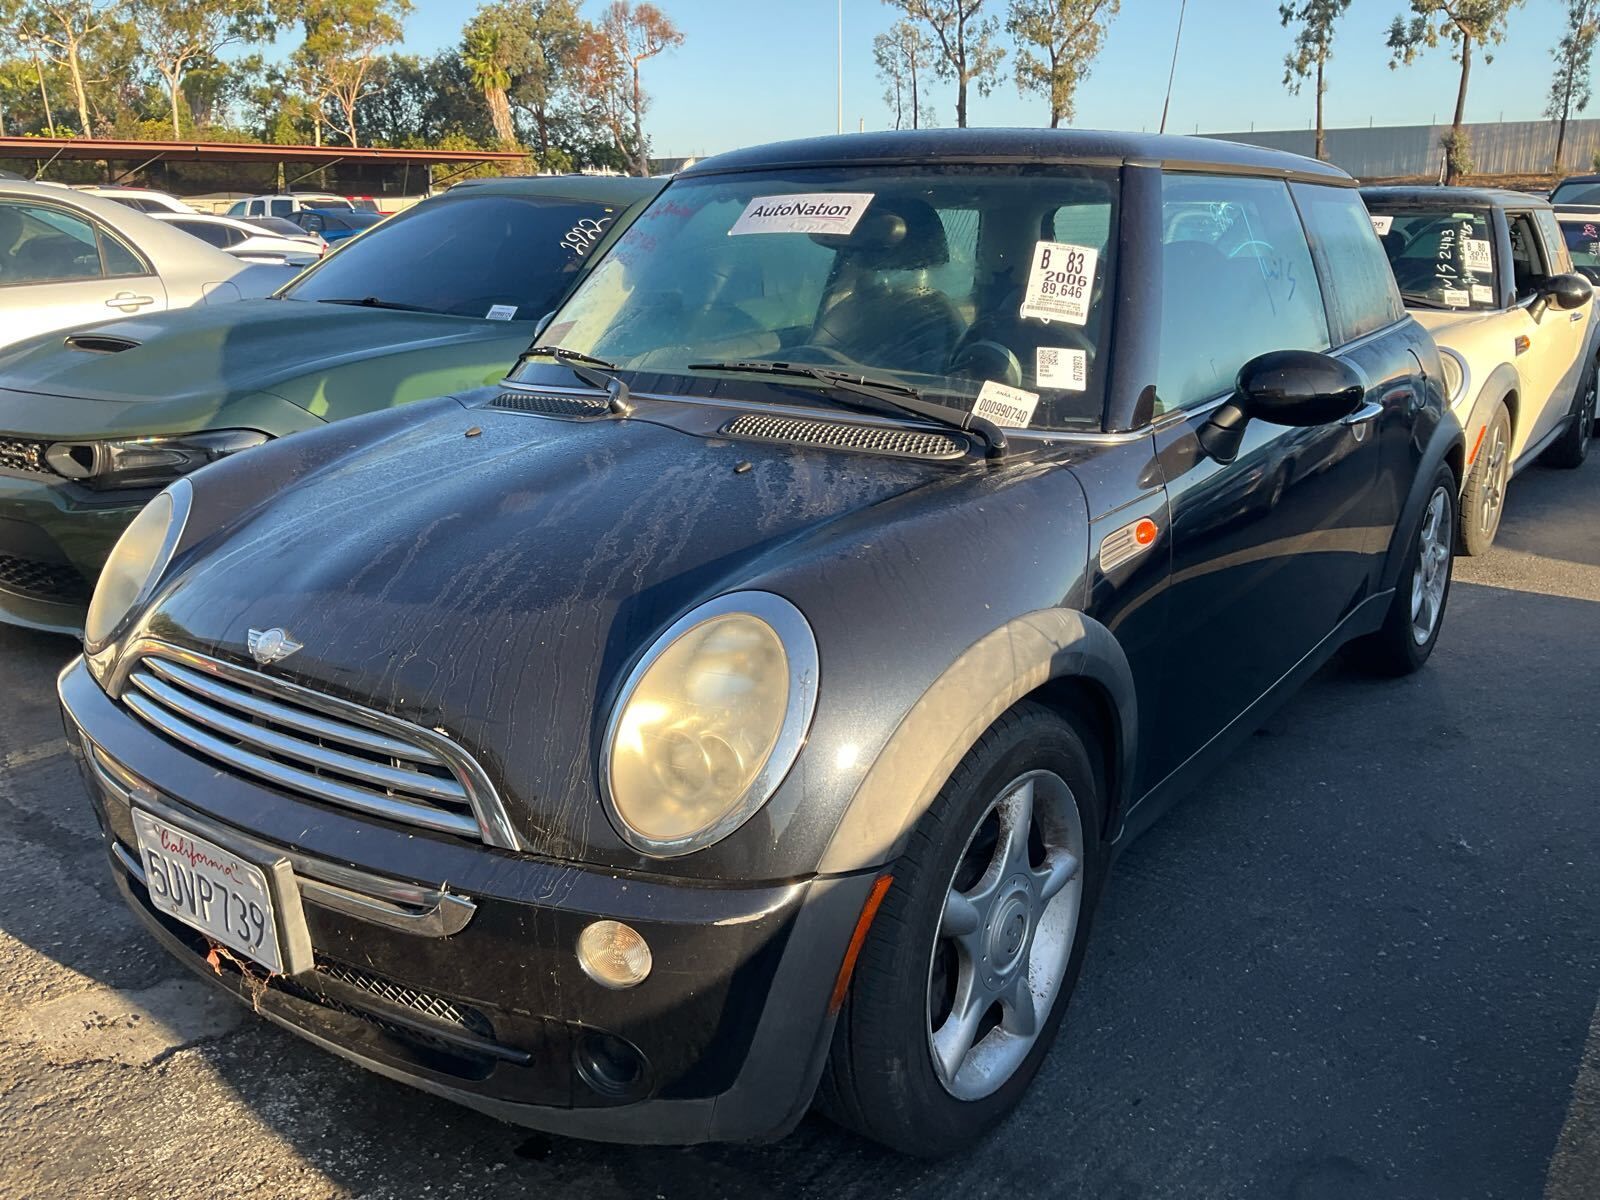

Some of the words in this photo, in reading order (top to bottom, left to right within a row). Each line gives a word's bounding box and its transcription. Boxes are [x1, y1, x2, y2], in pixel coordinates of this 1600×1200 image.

[749, 202, 852, 218] AutoNation
[1439, 229, 1456, 260] 2443
[1040, 248, 1052, 270] B
[1066, 251, 1085, 275] 83
[1041, 281, 1083, 299] 89,646
[1044, 270, 1088, 287] 2006
[979, 398, 1028, 423] 000990740
[160, 828, 243, 886] California
[147, 847, 265, 949] 5UVP739
